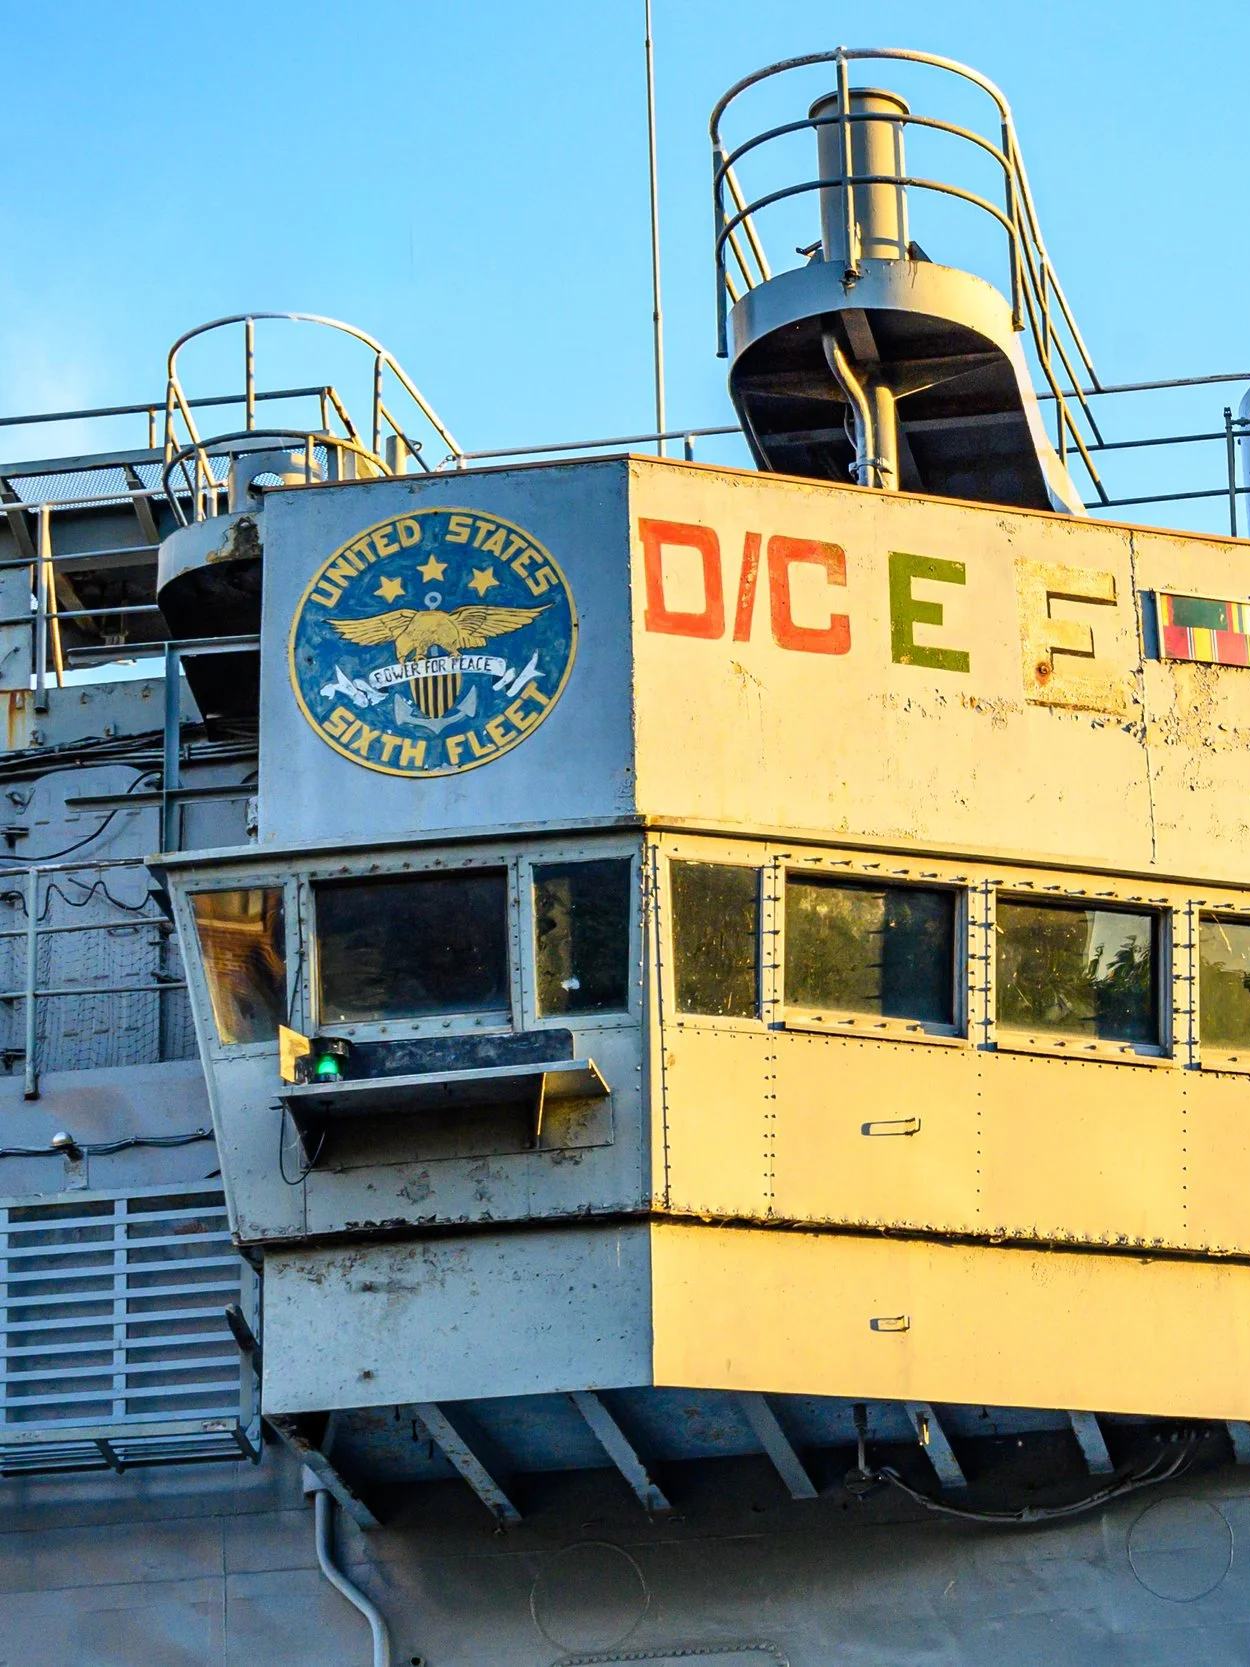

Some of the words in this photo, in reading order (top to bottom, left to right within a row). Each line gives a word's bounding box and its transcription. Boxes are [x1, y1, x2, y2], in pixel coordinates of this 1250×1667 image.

[311, 517, 422, 608] UNITED
[445, 515, 559, 597] STATES
[888, 551, 970, 673] E
[374, 663, 421, 683] POWER
[424, 659, 448, 674] FOR
[451, 656, 492, 671] PEACE
[322, 706, 427, 767] SIXTH
[446, 681, 550, 765] FLEET
